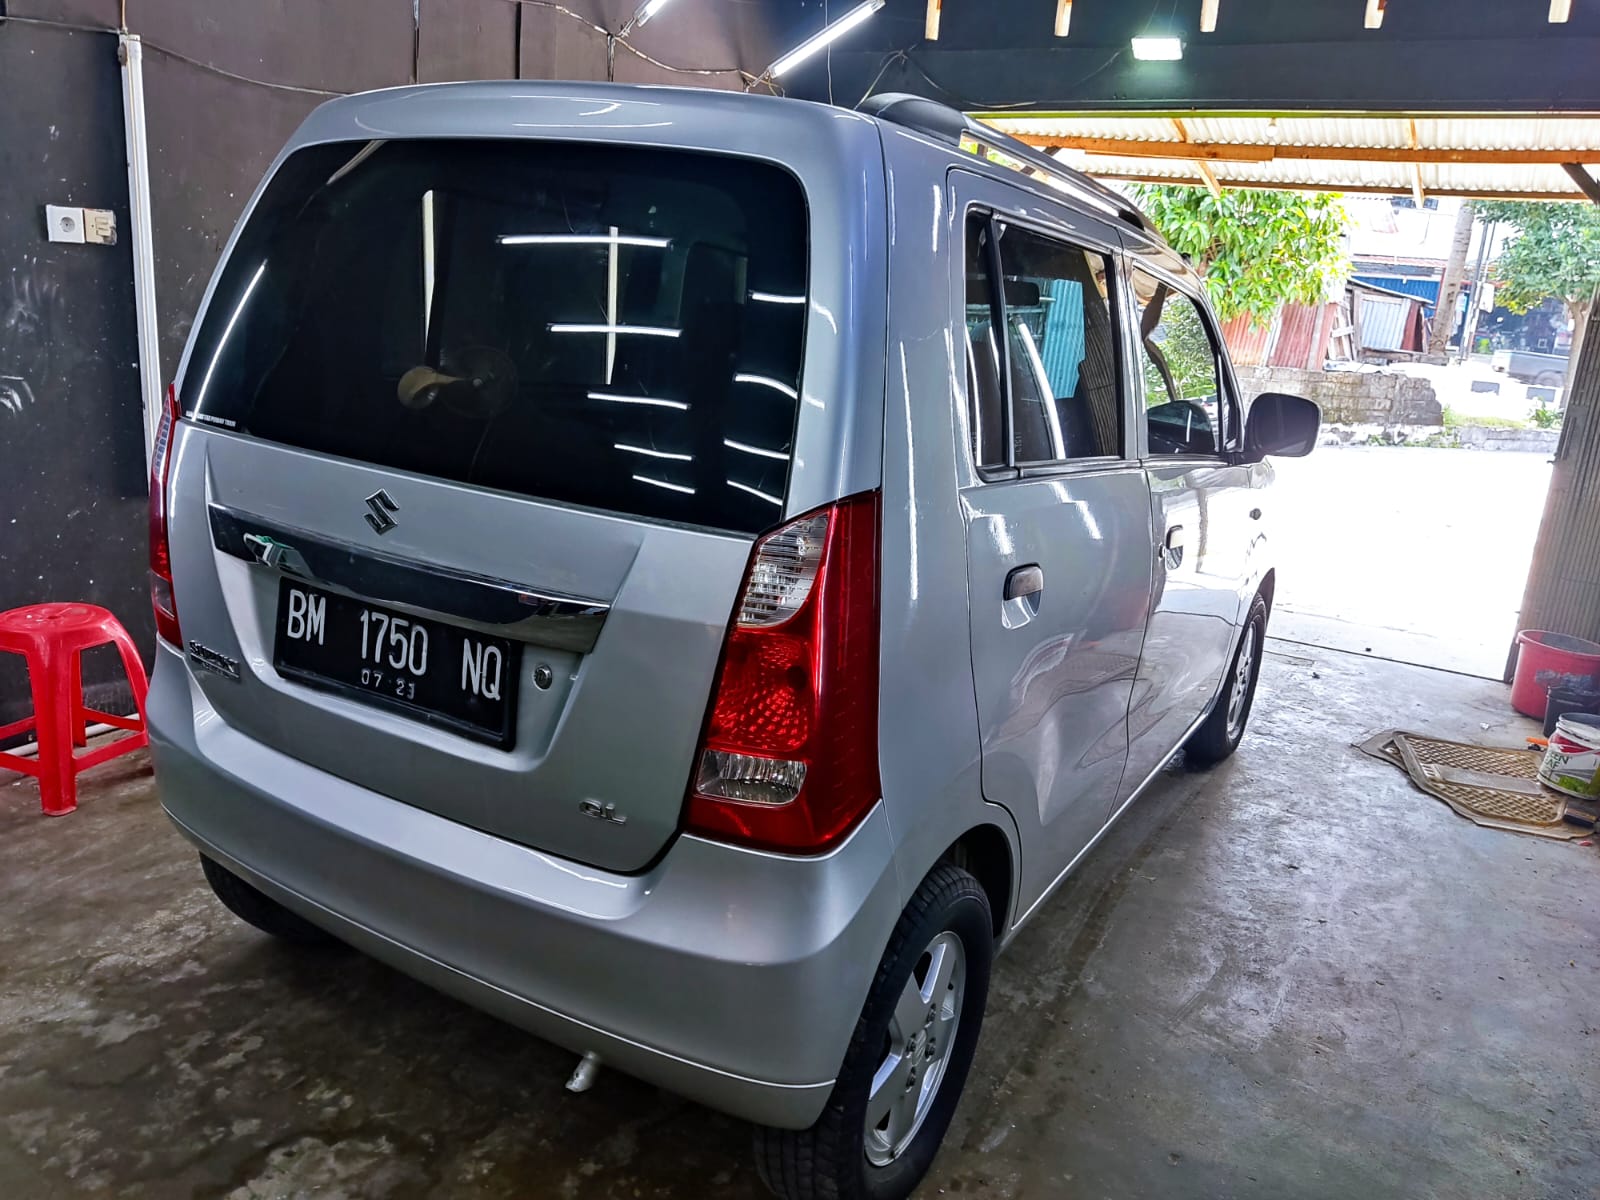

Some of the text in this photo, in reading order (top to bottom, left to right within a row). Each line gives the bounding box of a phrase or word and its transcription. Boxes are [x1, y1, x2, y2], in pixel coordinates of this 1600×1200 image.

[287, 588, 501, 700] BM 1750 NQ
[361, 670, 383, 688] 07
